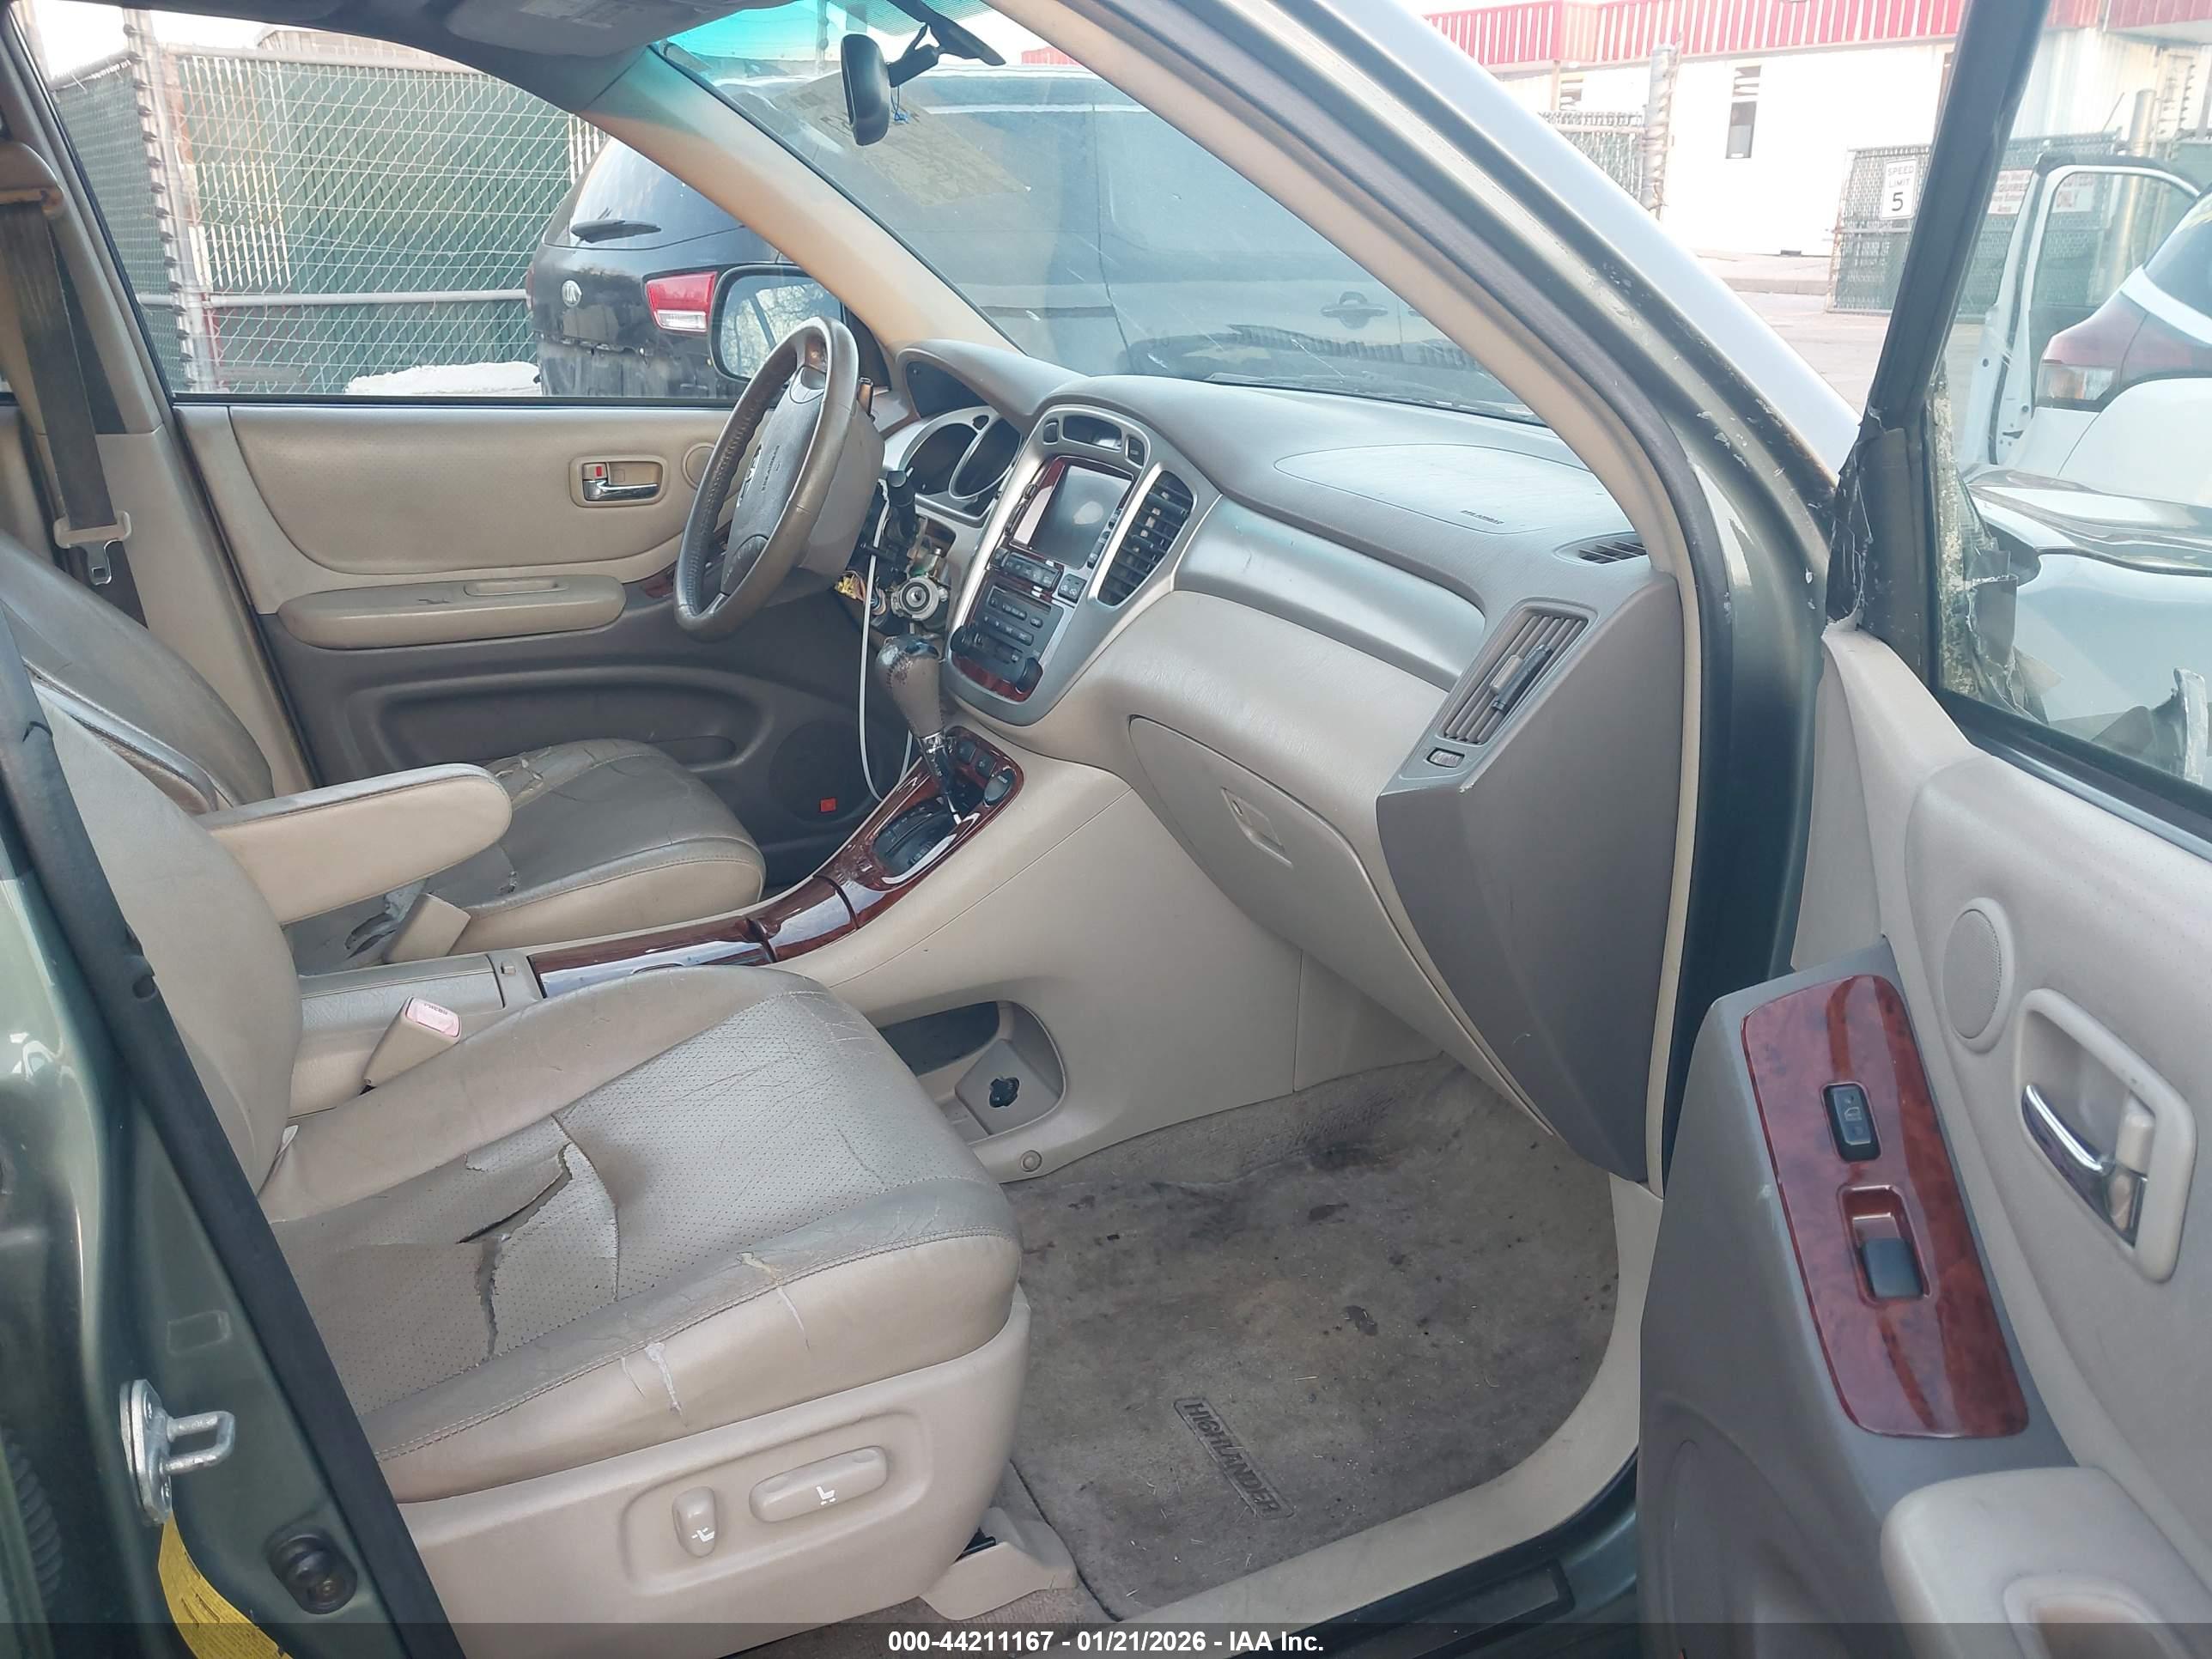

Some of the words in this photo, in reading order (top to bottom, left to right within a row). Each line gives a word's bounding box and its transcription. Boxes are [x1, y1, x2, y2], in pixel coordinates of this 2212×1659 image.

[1887, 165, 1915, 177] SPEED
[1888, 178, 1911, 188] LIMIT
[1892, 191, 1904, 211] 5
[1183, 1402, 1281, 1512] HIGHLANDER
